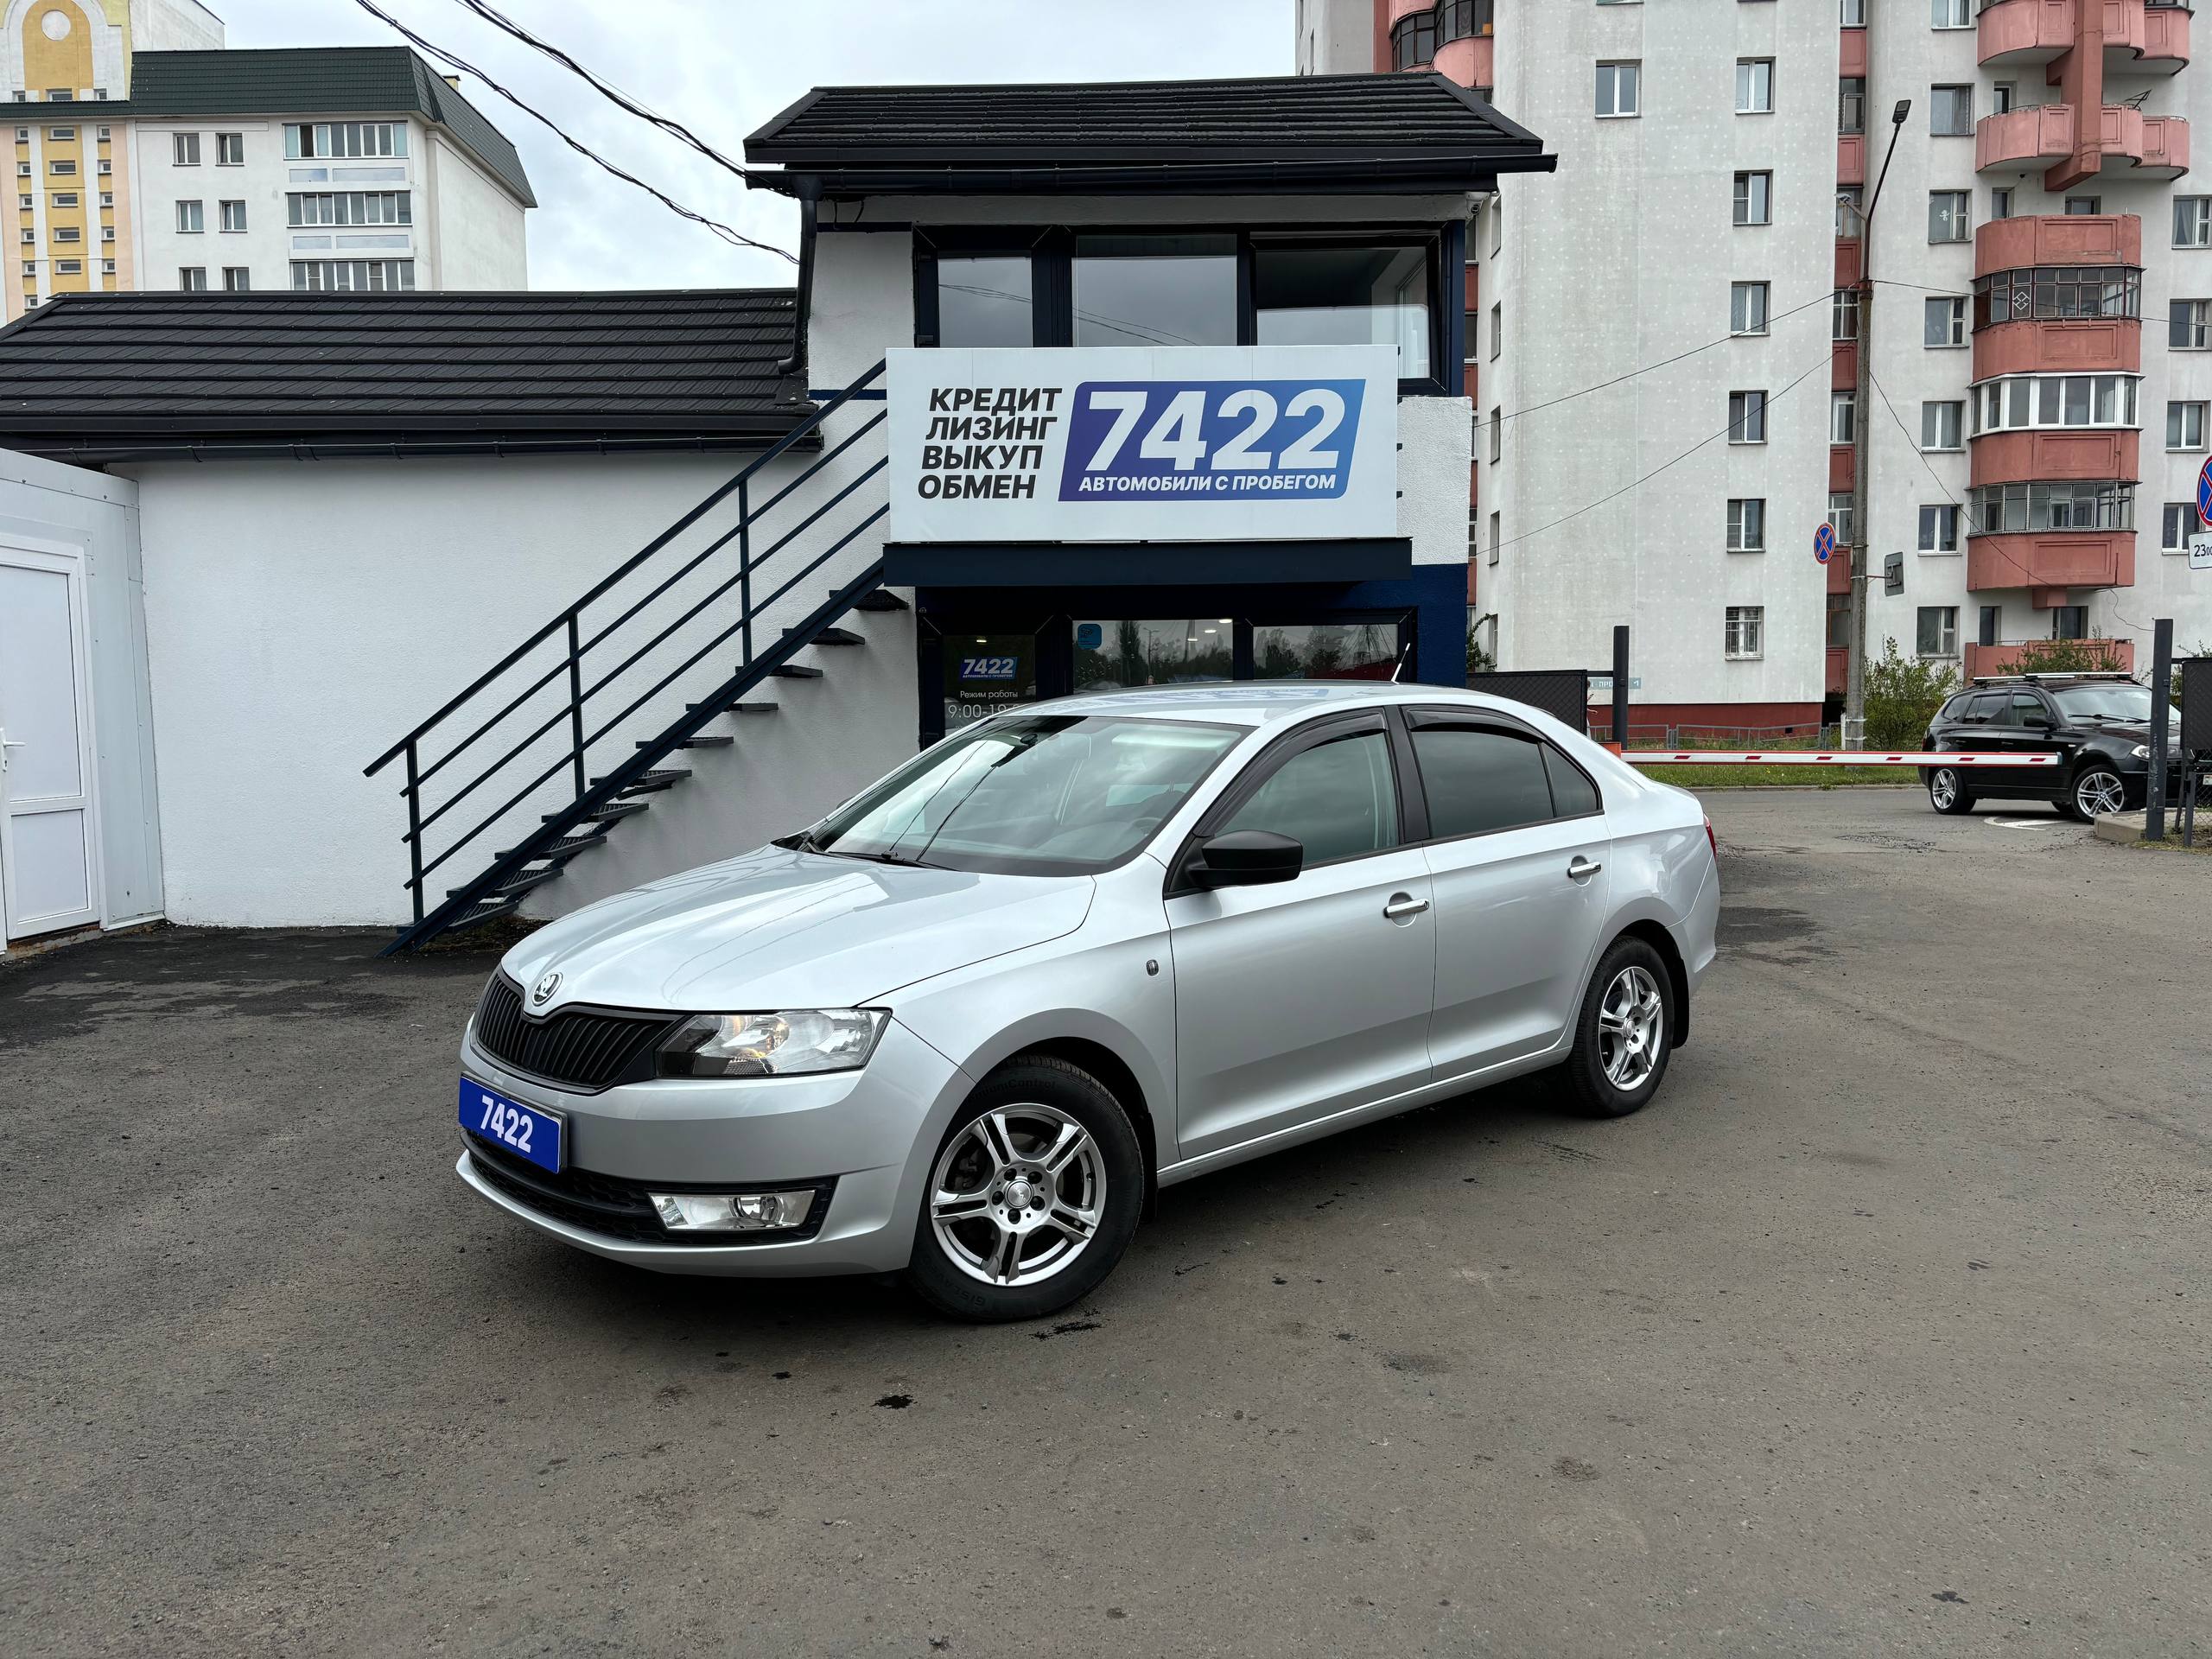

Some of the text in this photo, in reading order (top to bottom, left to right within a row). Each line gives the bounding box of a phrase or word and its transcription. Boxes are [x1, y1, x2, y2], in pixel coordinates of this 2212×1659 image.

[929, 388, 1062, 416] КРЕДИТ
[925, 416, 1058, 440] ЛИЗИНГ
[1084, 389, 1345, 471] 7422
[921, 445, 1043, 469] ВЫКУП
[918, 474, 1036, 499] ОБМЕН
[1078, 474, 1336, 492] АВТОМОБИЛИ С ПРОБЕГОМ
[963, 658, 1014, 674] 7422
[960, 690, 1018, 700] Режим работы
[480, 1095, 533, 1153] 7422
